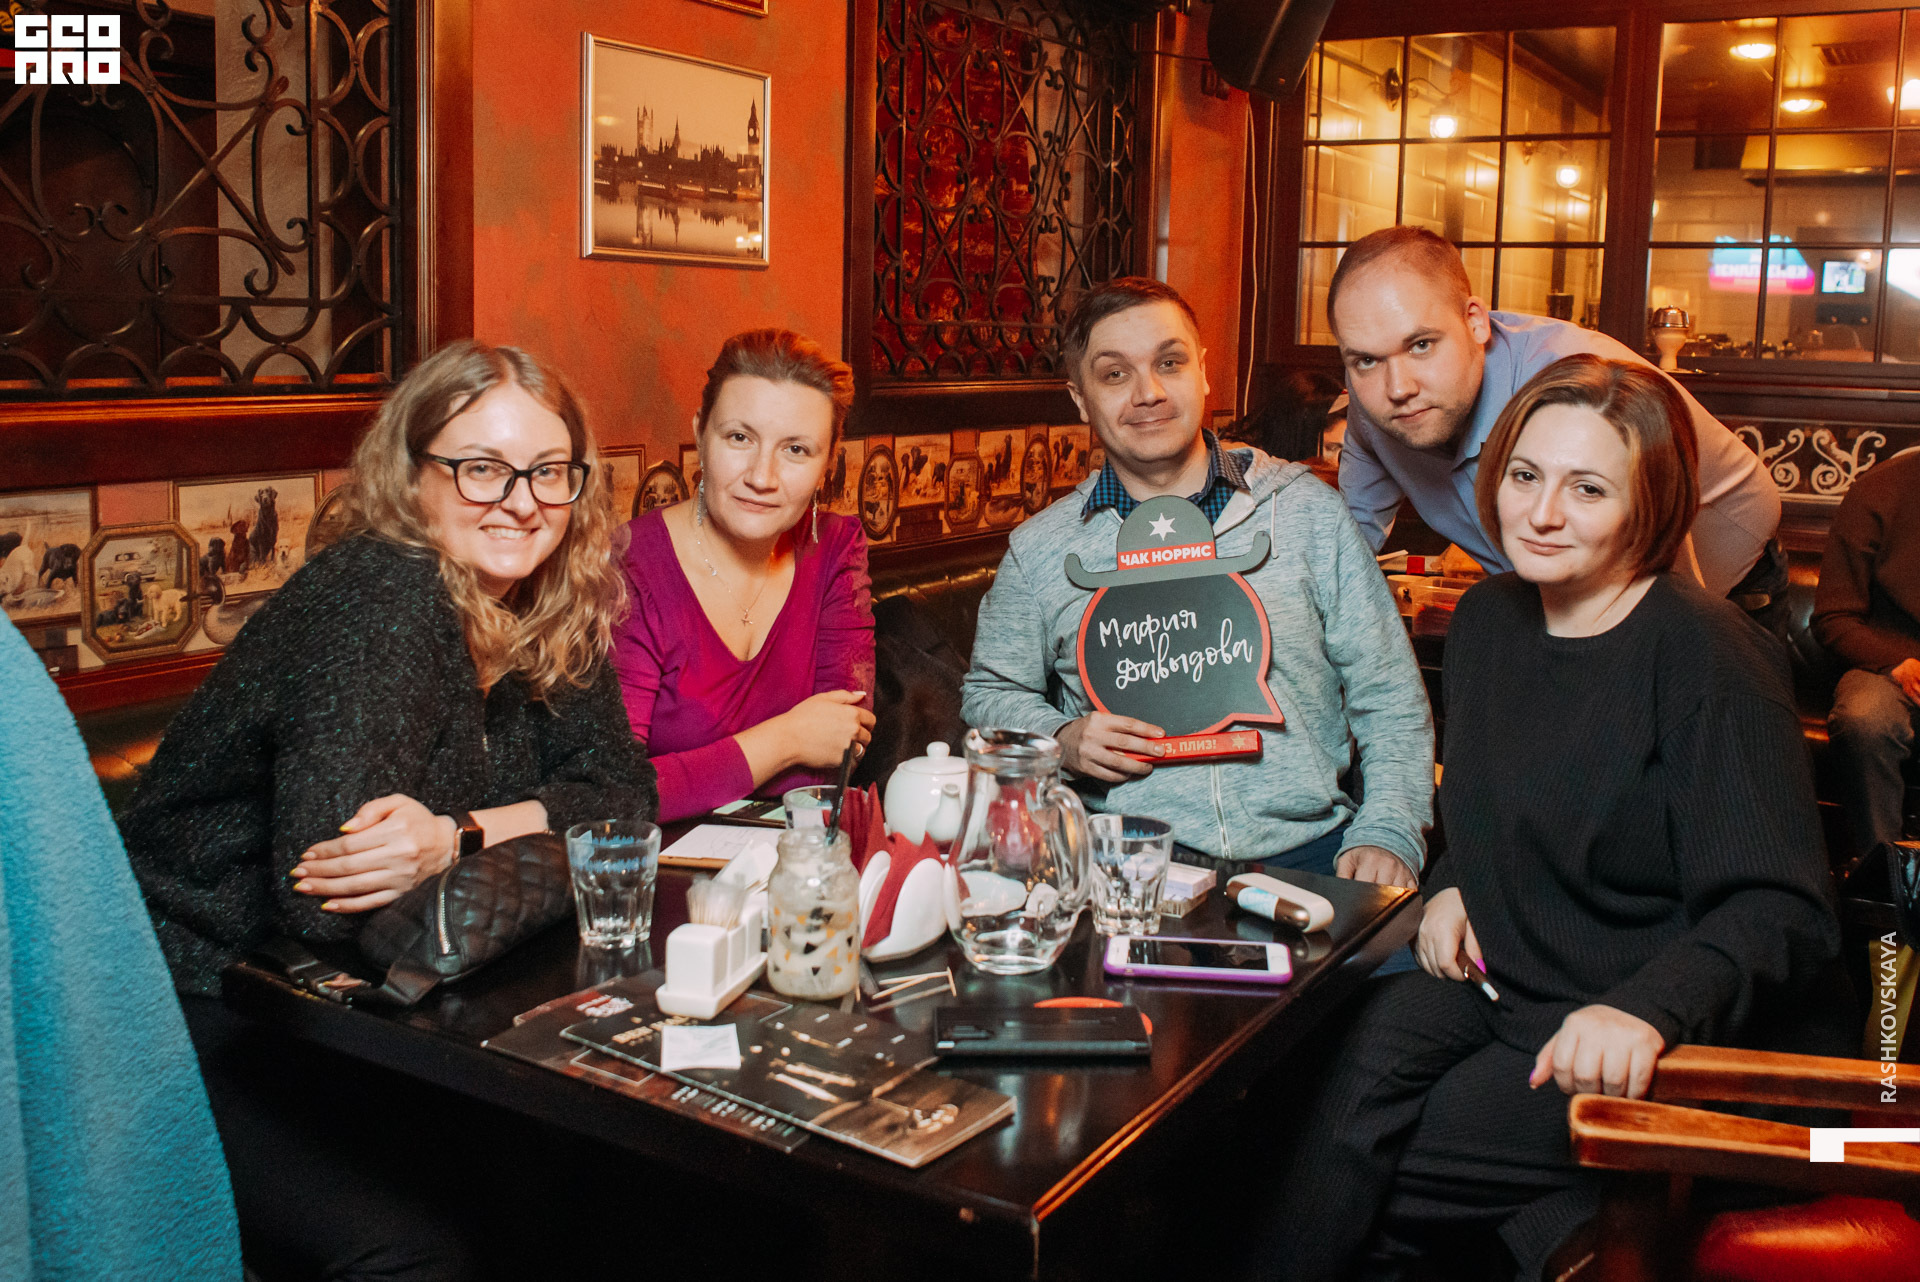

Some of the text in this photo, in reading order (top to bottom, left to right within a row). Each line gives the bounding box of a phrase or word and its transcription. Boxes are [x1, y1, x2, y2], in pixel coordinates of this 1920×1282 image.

[1120, 545, 1212, 566] ЧАК НОРРИС
[1099, 609, 1198, 653] Мафия
[1115, 617, 1253, 690] Давыдова
[1179, 739, 1217, 752] ПЛИЗ!
